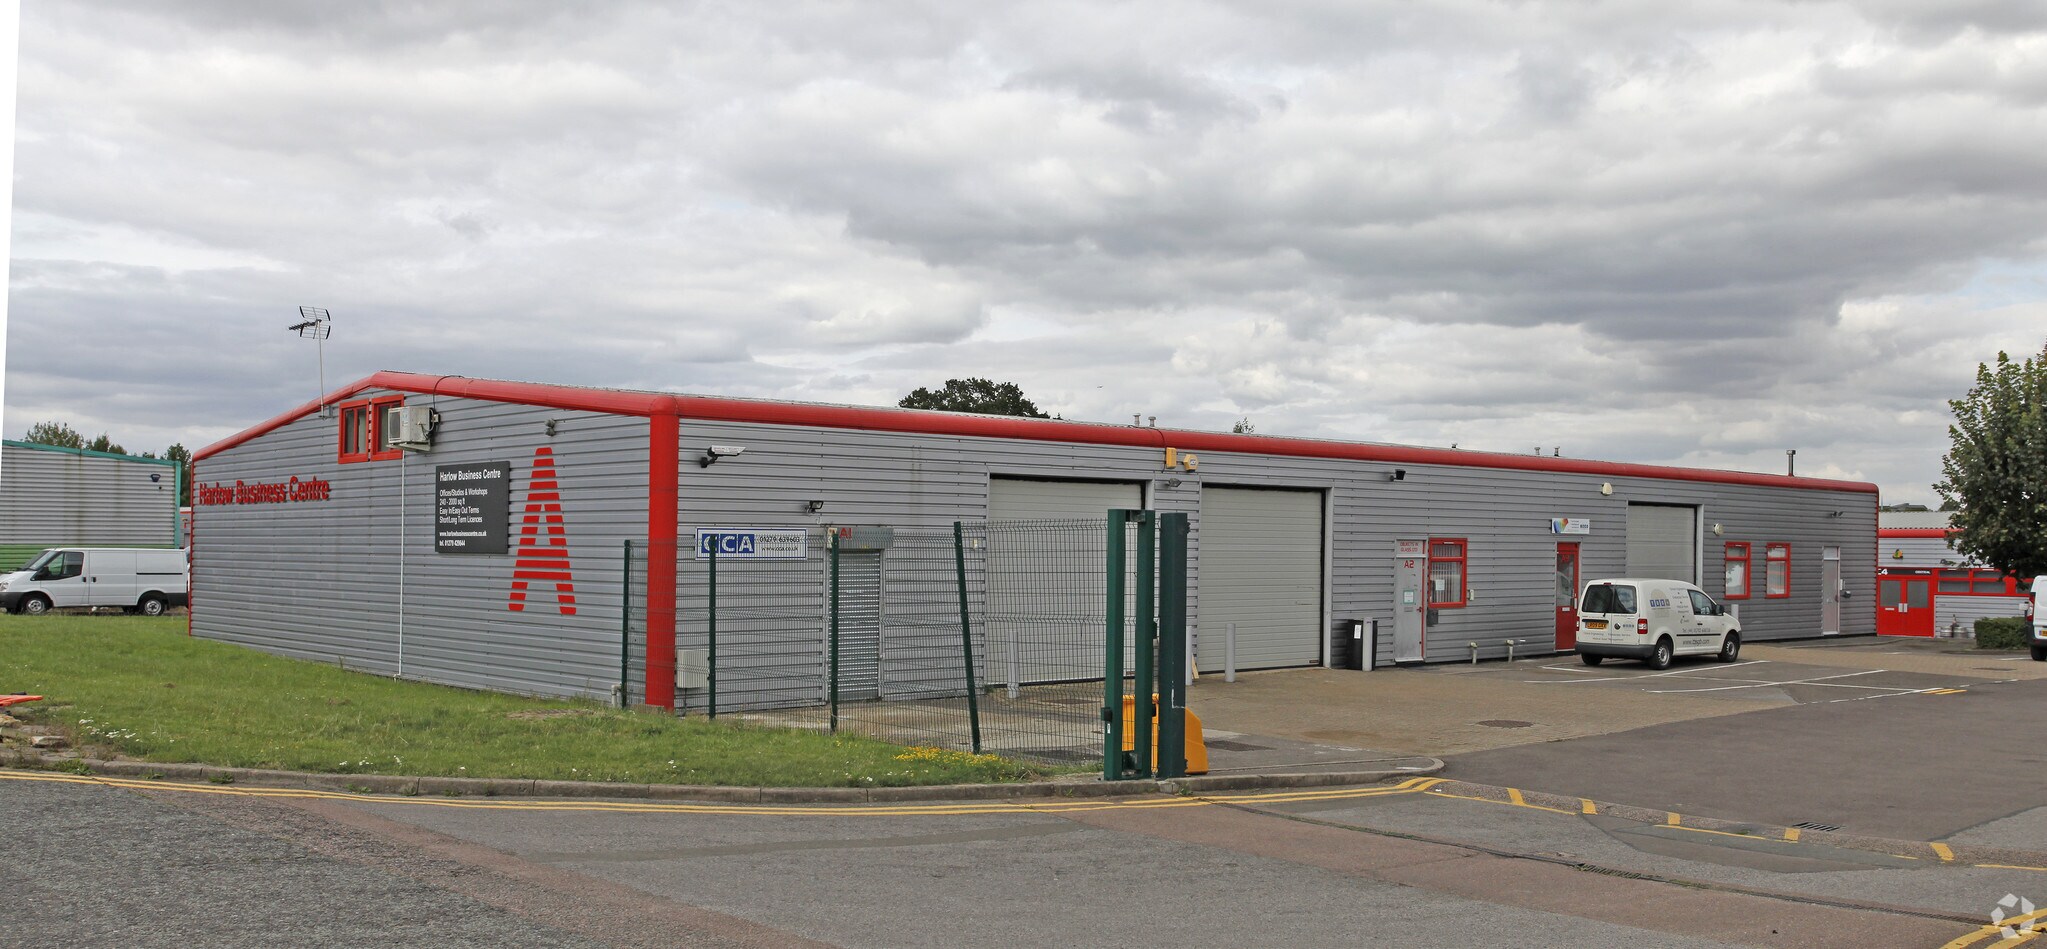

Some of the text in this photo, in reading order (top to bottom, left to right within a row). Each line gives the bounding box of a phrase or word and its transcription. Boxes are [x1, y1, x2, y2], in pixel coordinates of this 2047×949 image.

[440, 469, 501, 482] Harlow Business Centre
[199, 476, 330, 505] Harlow Business Centre
[468, 488, 488, 496] Workshops
[440, 507, 448, 516] Easy
[468, 506, 479, 514] Terms
[508, 447, 576, 615] A
[1404, 560, 1415, 568] A2
